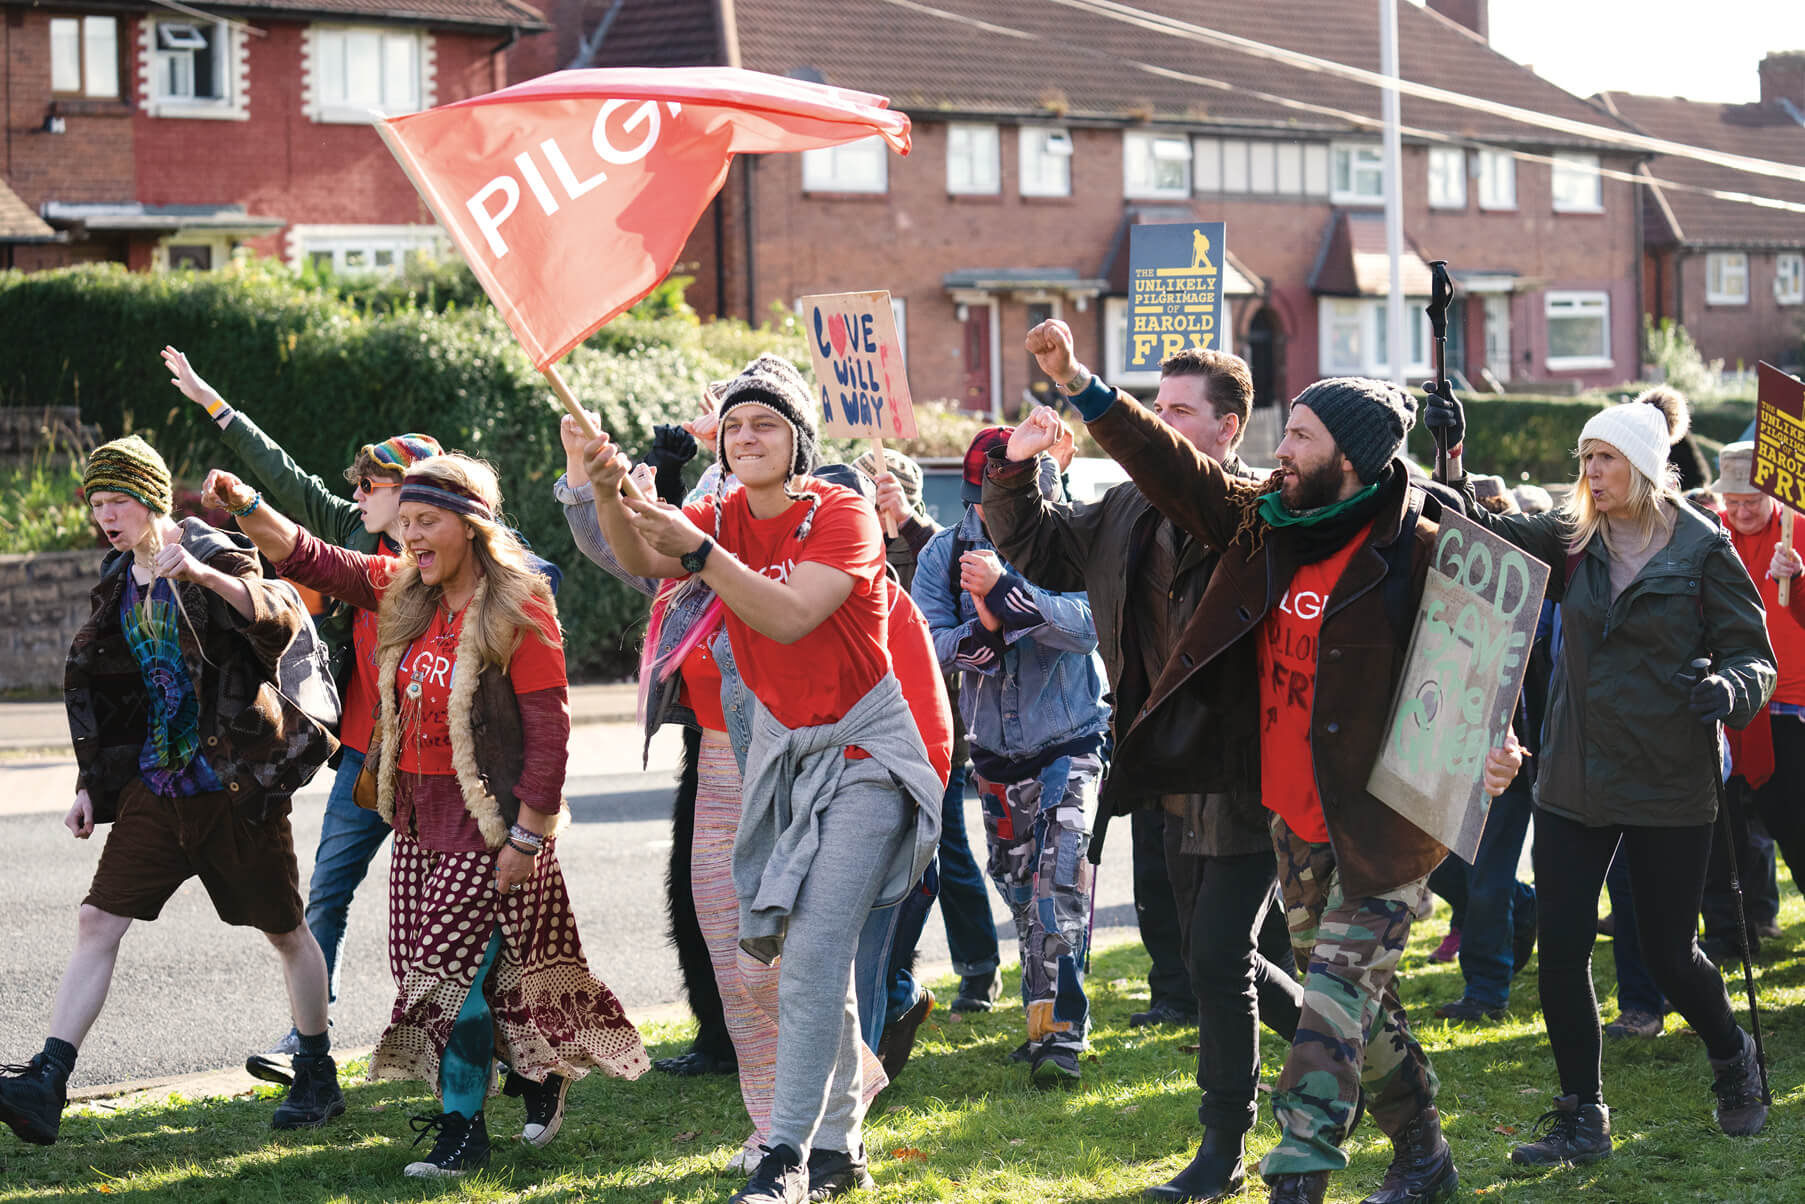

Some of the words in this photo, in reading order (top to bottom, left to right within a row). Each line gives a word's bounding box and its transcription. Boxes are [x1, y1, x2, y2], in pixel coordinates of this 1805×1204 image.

[465, 98, 682, 259] PILG
[1135, 268, 1154, 277] THE
[1135, 278, 1217, 292] UNLIKELY
[1135, 293, 1215, 304] PILGRIMAGE
[1167, 305, 1180, 314] OF
[1134, 315, 1214, 332] HAROLD
[822, 384, 834, 423] A
[840, 391, 884, 429] WAY
[1760, 409, 1805, 442] UNLIKE
[1758, 441, 1805, 479] HAROL
[1436, 528, 1530, 621] GOD
[1422, 599, 1527, 688] SAVE
